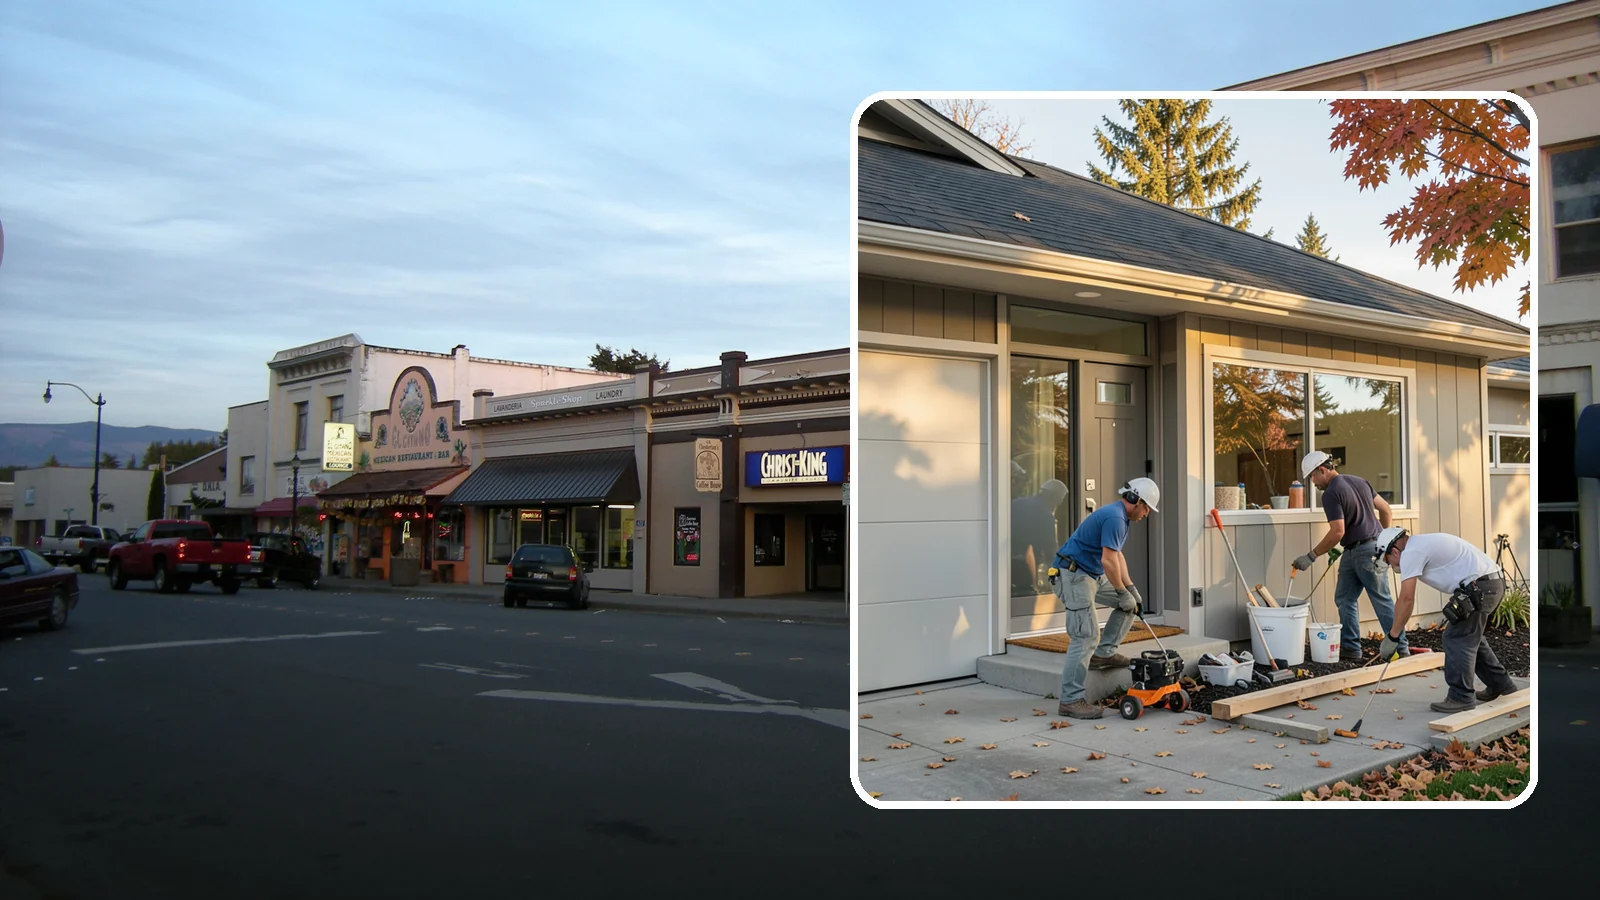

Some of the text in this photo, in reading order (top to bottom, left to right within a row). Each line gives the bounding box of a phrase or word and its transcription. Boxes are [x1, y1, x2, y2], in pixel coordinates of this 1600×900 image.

[493, 388, 624, 412] LAVANDERIA Sparkle Shop LAUNDRY
[373, 455, 396, 464] MEXICAN
[397, 452, 433, 462] RESTAURANT
[438, 450, 450, 459] BAR
